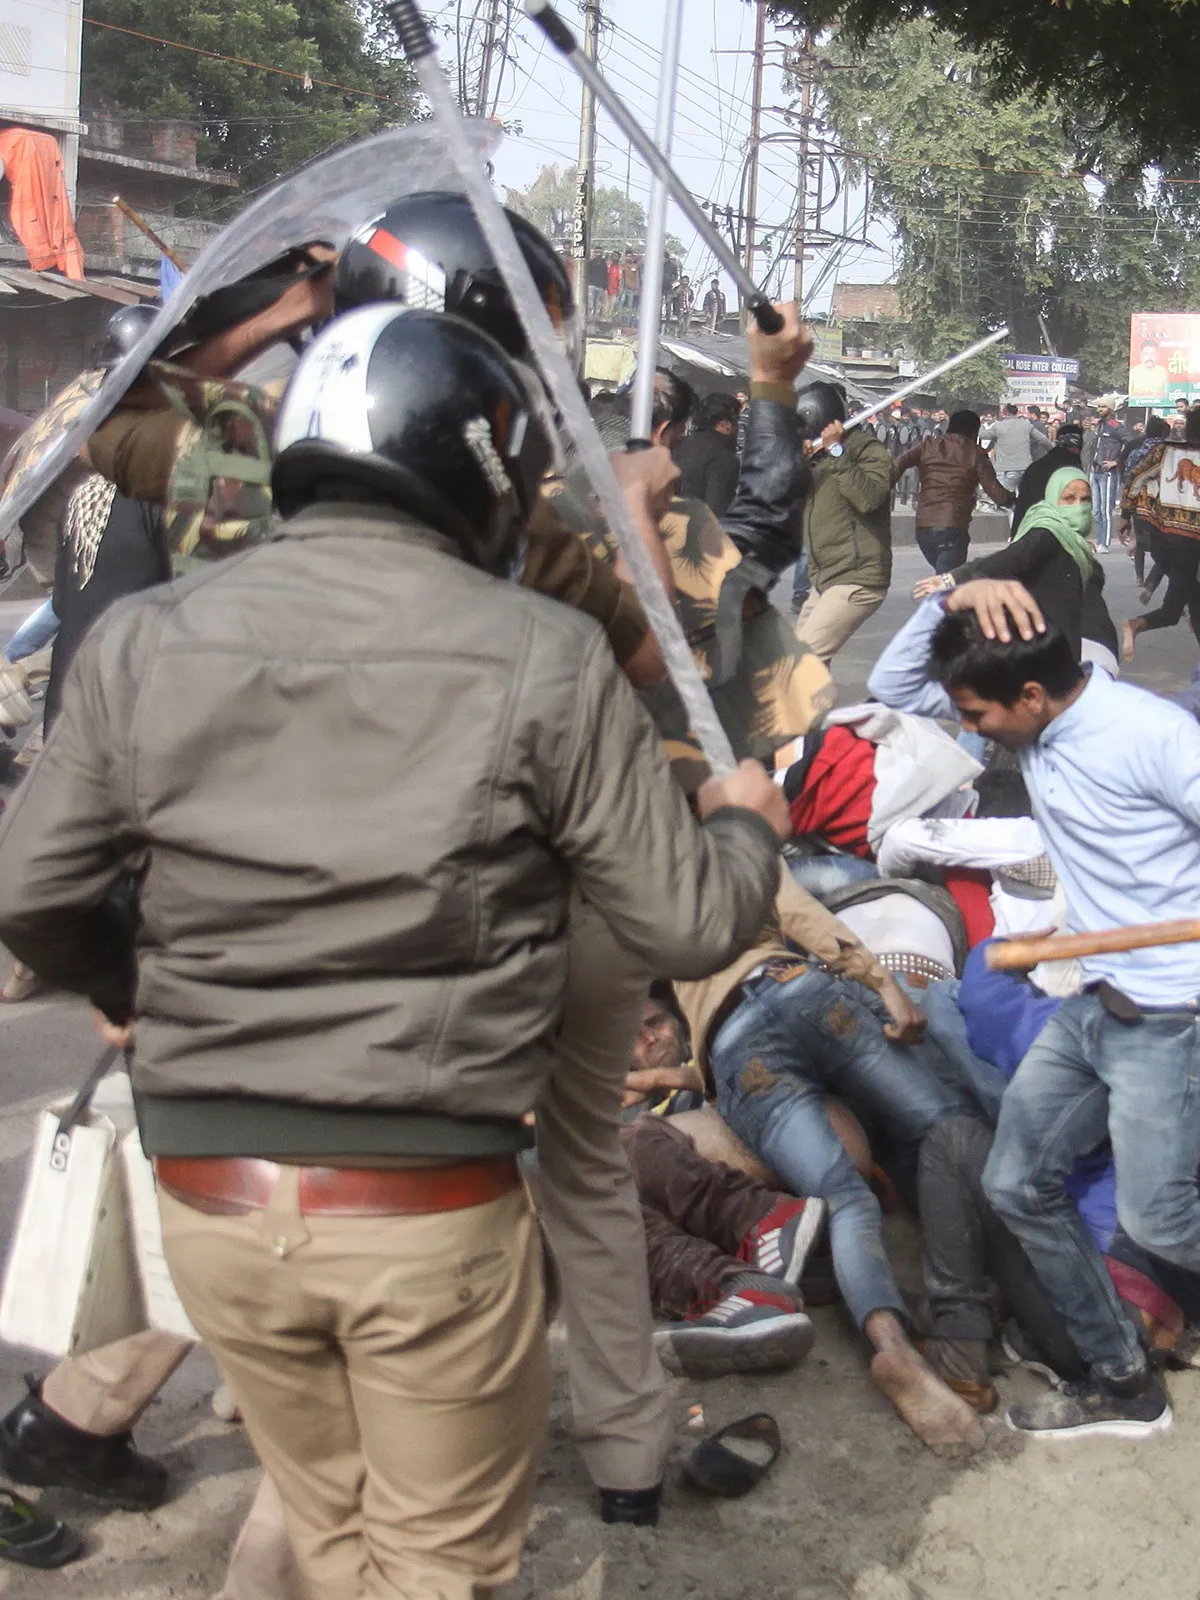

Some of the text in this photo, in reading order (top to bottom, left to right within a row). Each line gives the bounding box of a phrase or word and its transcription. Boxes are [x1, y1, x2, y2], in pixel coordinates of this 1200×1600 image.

[1016, 360, 1031, 371] ROSE
[1032, 361, 1049, 372] INTER
[1051, 362, 1078, 374] COLLEGE
